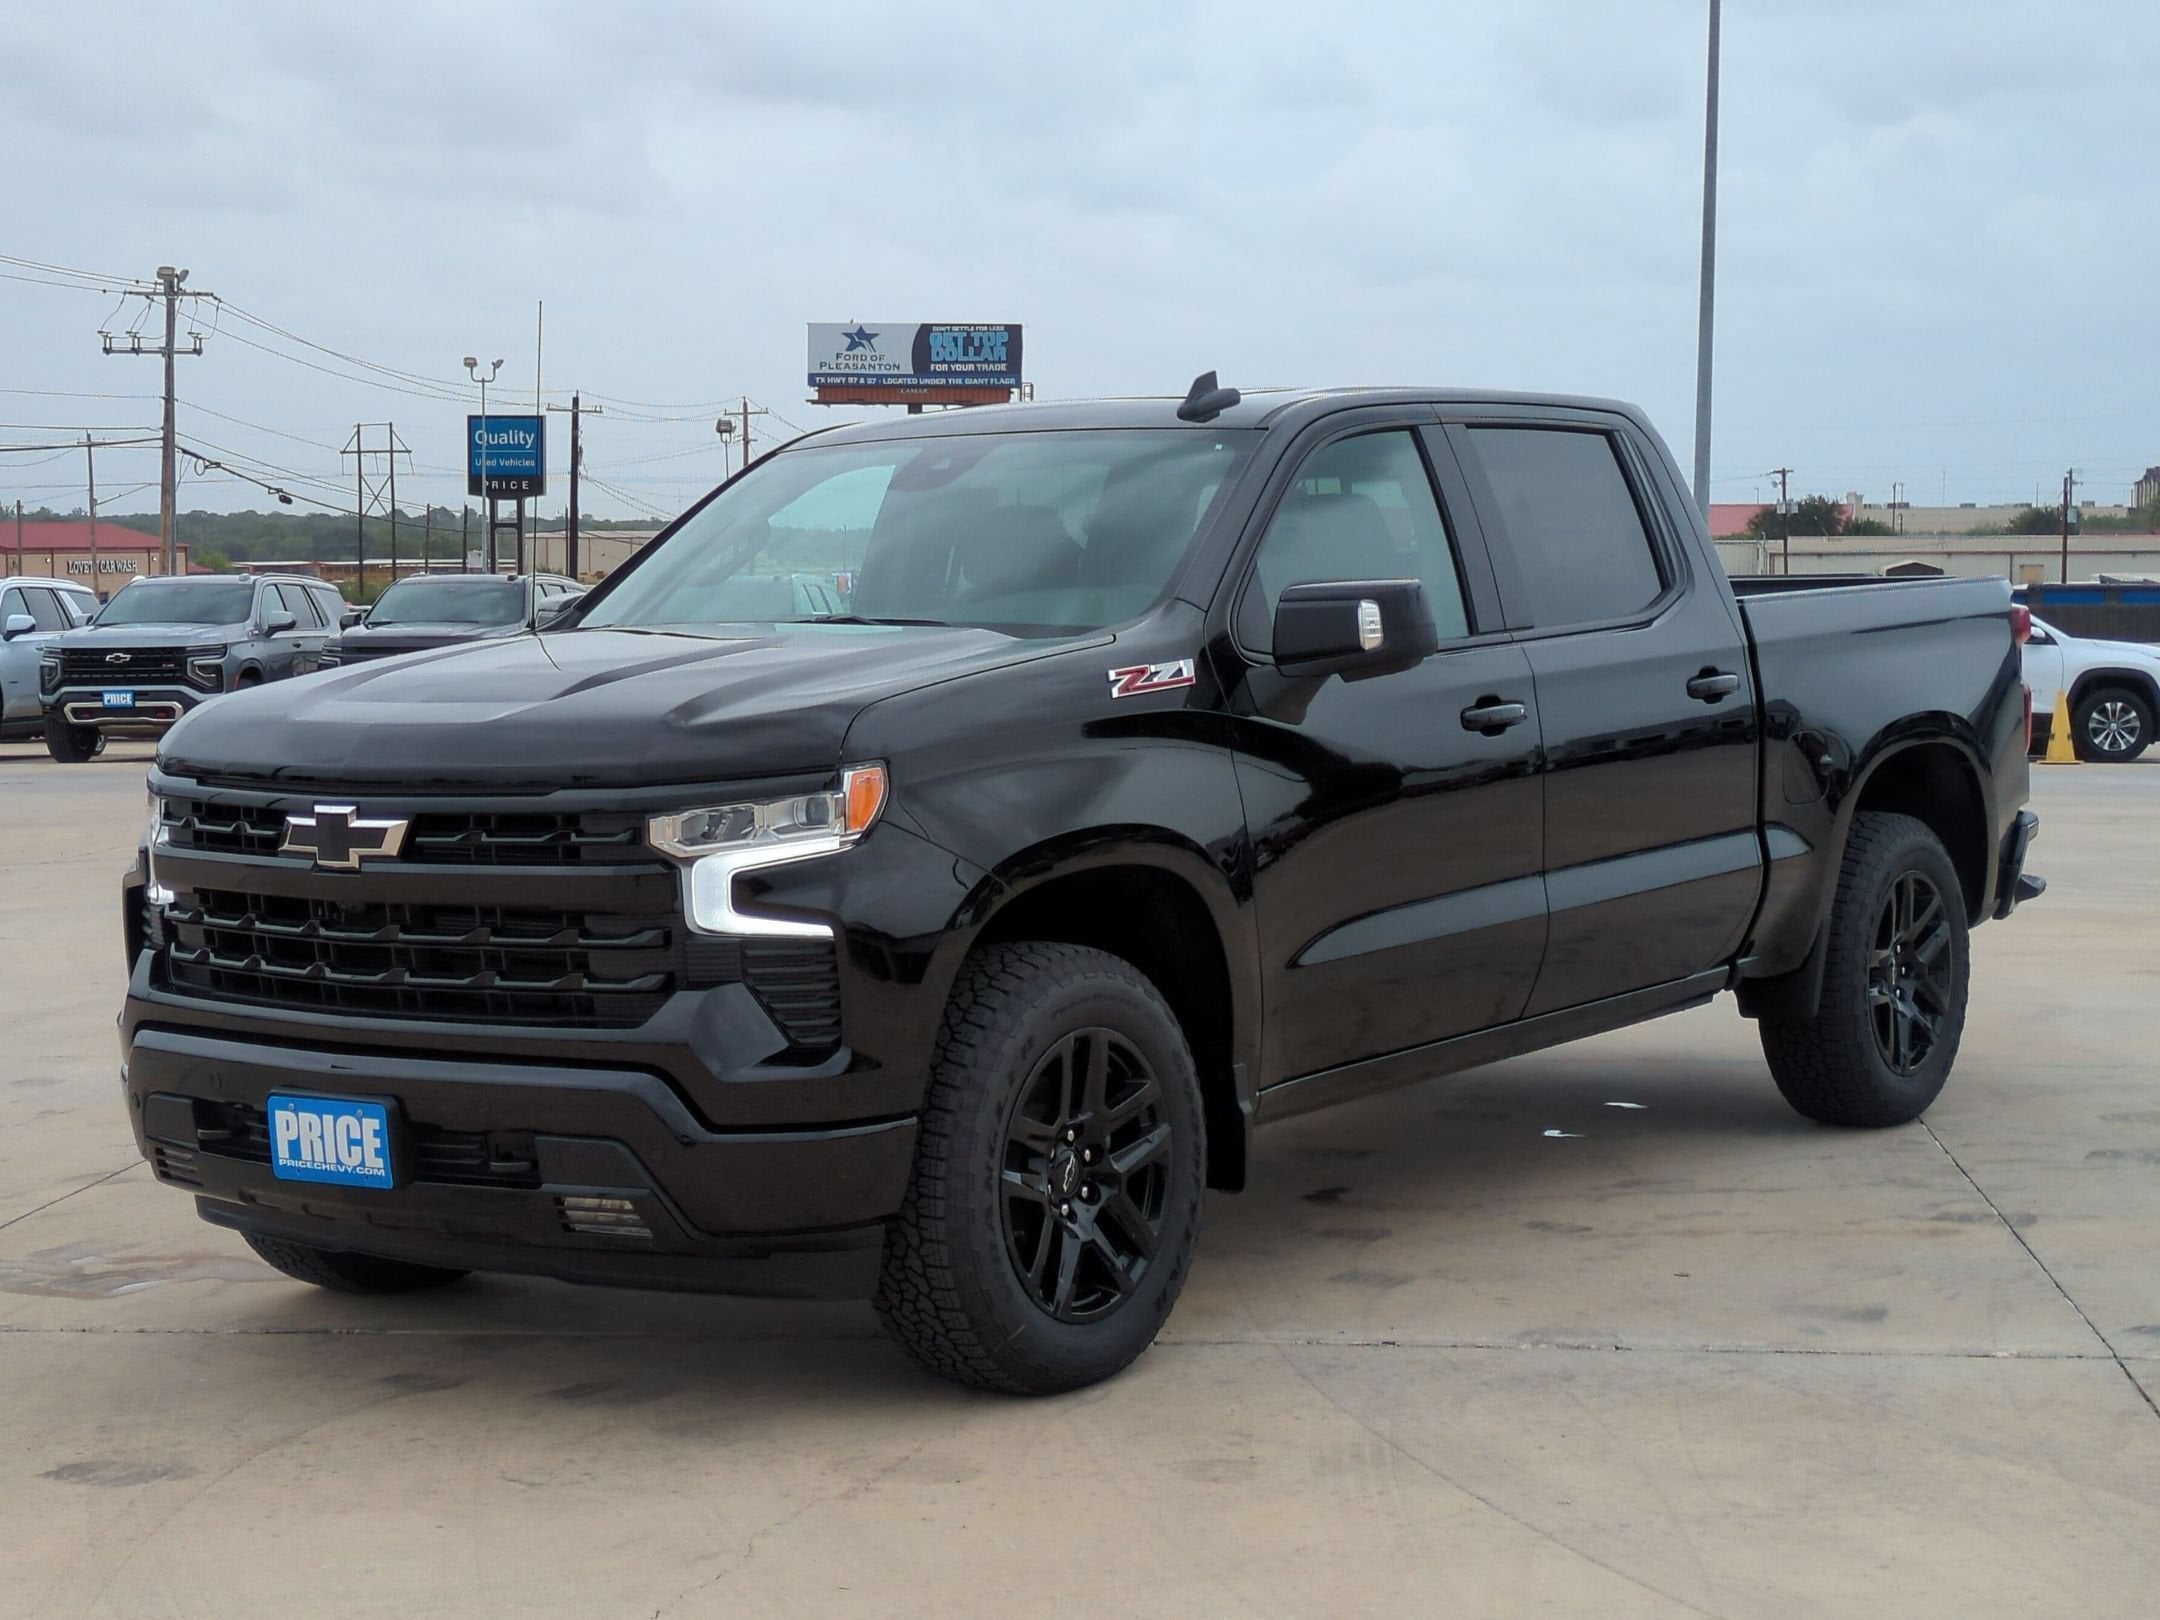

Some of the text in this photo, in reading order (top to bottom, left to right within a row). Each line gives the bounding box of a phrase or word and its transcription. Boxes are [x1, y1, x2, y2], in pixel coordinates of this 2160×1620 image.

[930, 332, 1009, 347] GET TOP
[836, 352, 886, 362] FORD OF
[931, 346, 1007, 361] DOLLAR
[819, 361, 901, 371] PLEASANTON
[930, 363, 1008, 372] FOR YOUR TRADE
[882, 377, 918, 385] LOCATED
[919, 377, 946, 385] UNDER
[474, 429, 535, 449] Quality
[475, 457, 536, 467] Ued Vehicles
[103, 693, 132, 705] PRICE
[274, 1109, 385, 1169] PRICE
[278, 1158, 386, 1177] PRICECHEVY.COM
